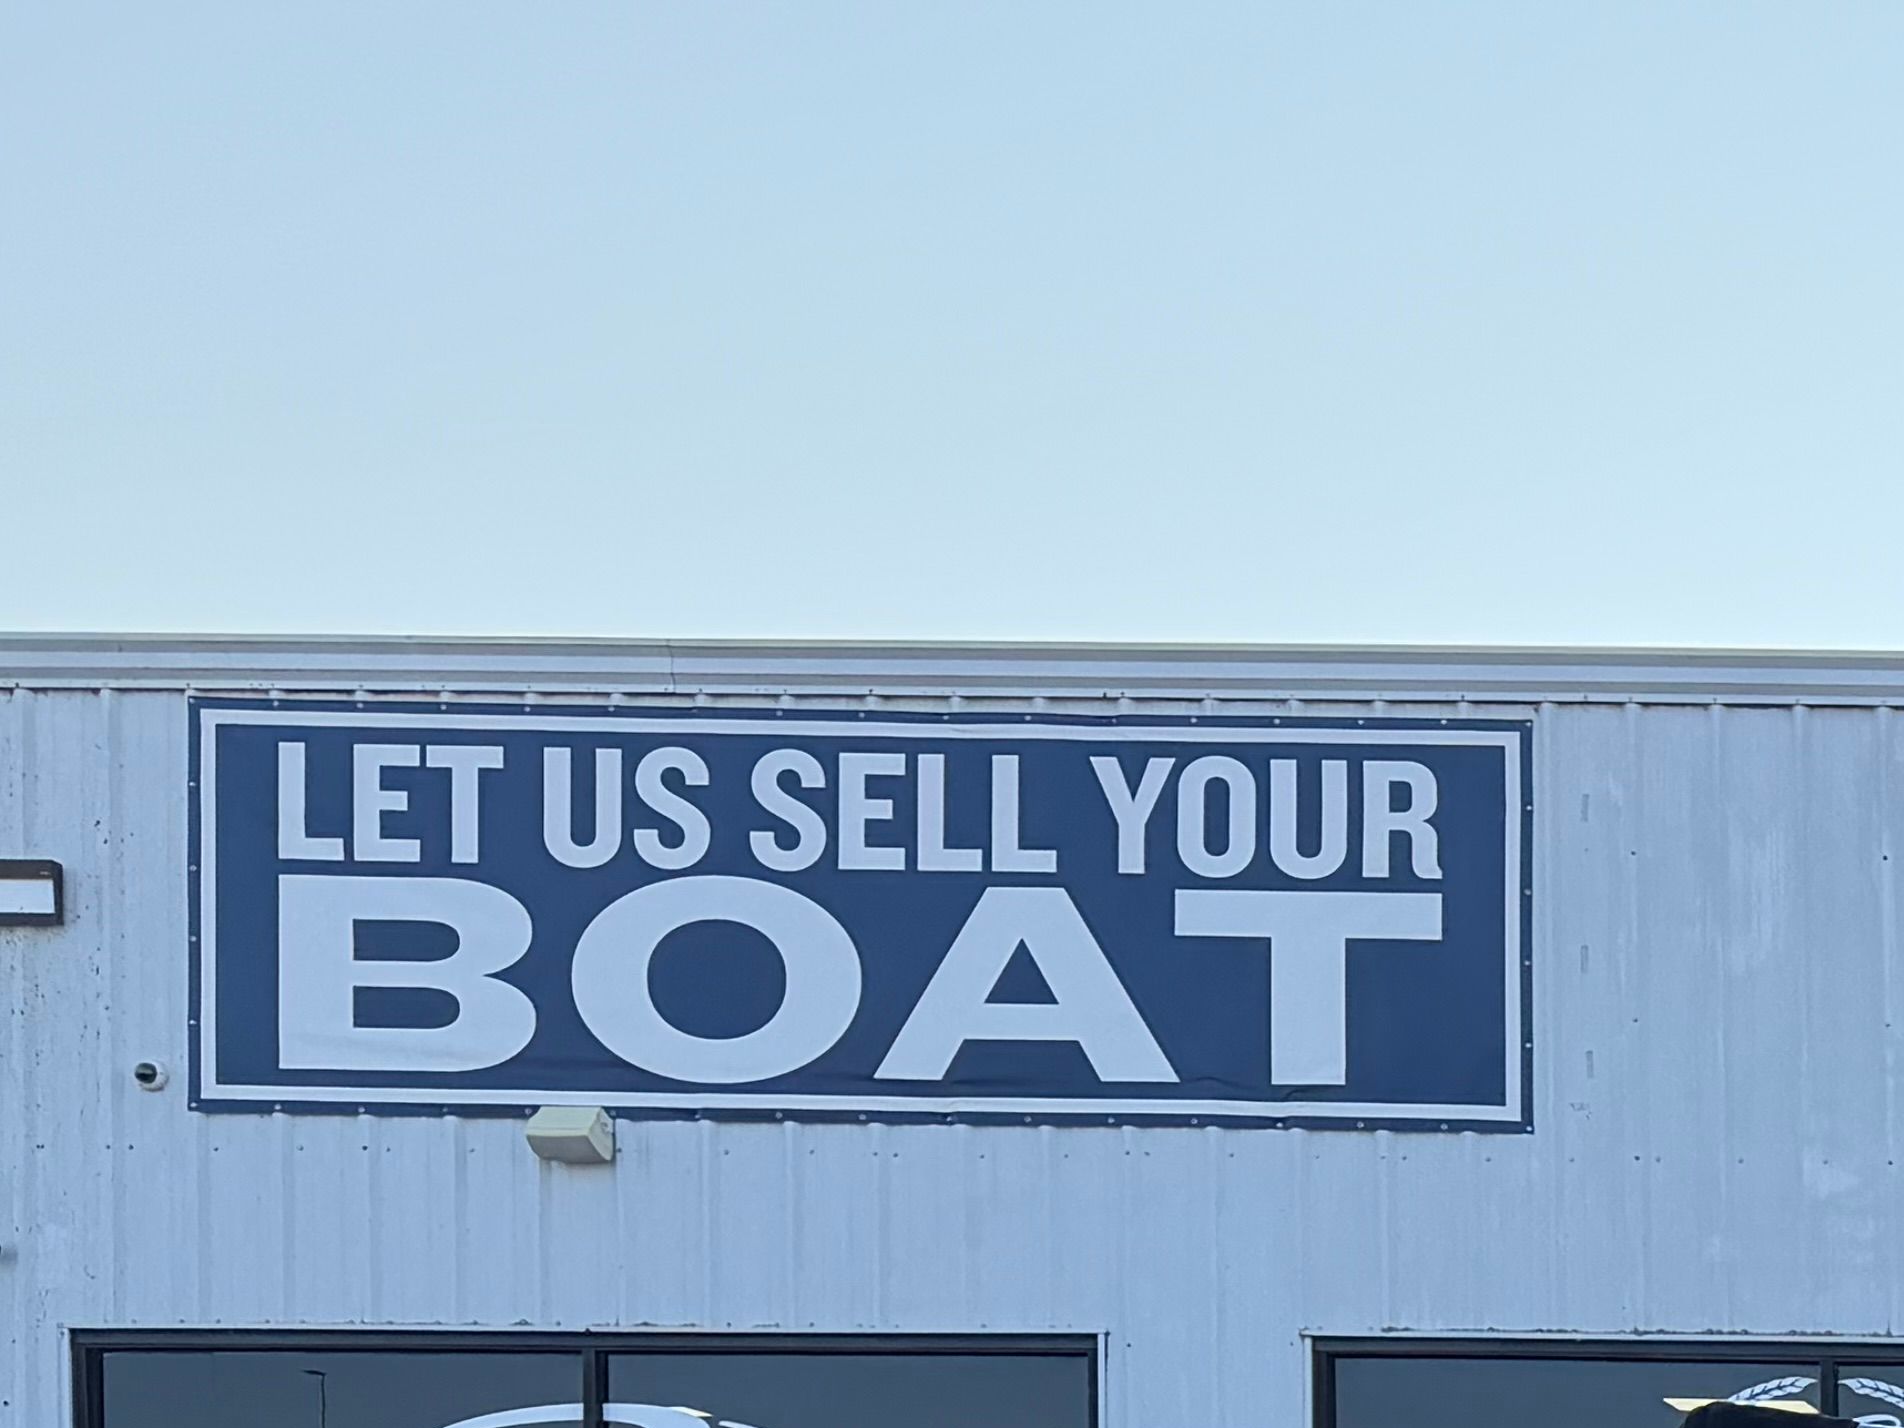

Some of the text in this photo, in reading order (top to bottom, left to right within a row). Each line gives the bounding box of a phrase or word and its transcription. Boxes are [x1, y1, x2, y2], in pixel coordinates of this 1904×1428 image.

[275, 742, 1444, 882] LET US SELL YOUR
[276, 872, 1444, 1088] BOAT
